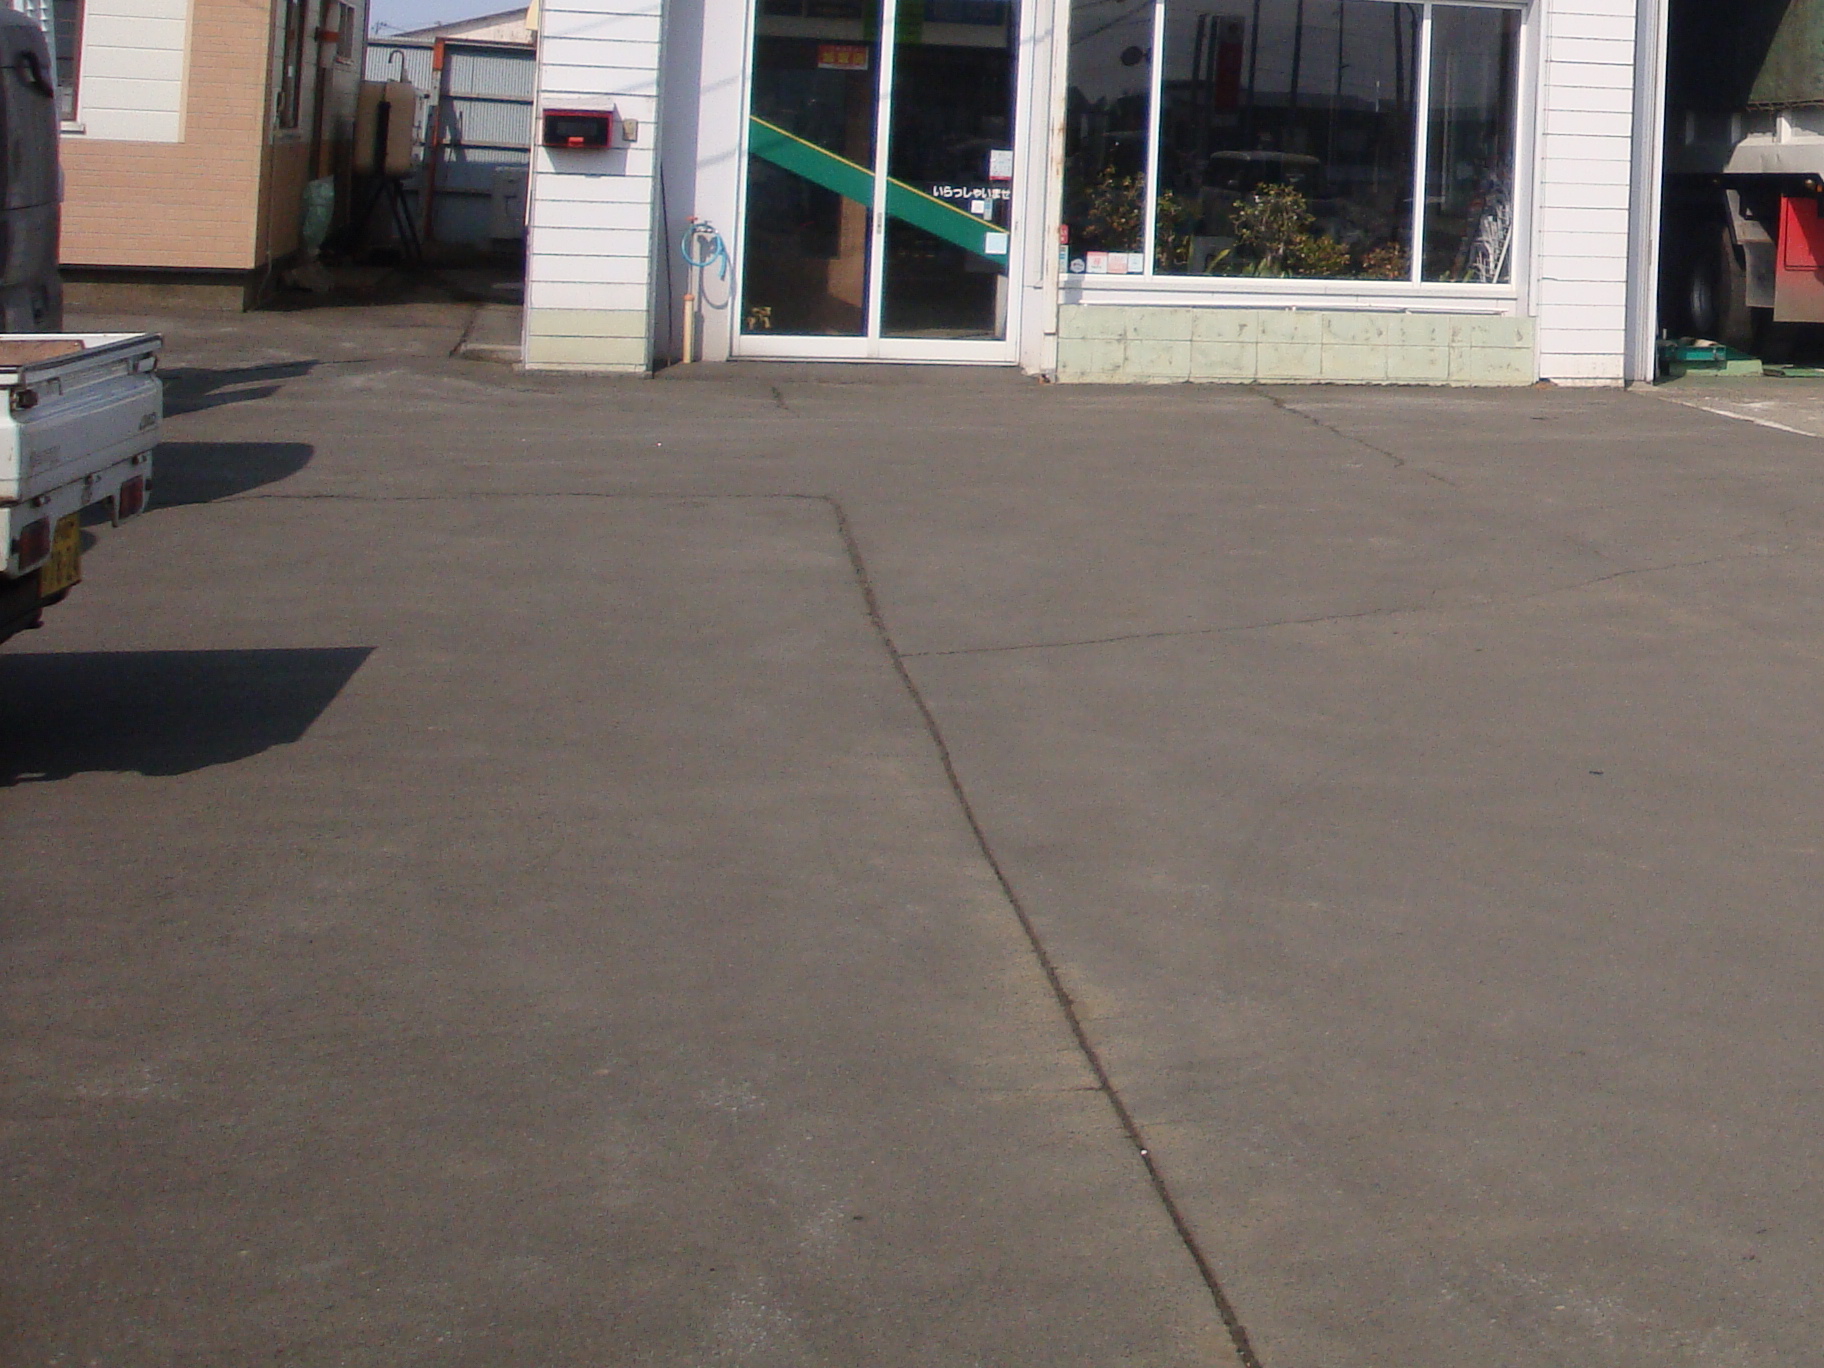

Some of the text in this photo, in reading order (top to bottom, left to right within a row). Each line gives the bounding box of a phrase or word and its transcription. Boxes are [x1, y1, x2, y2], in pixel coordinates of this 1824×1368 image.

[932, 185, 1011, 200] いらっしゃいませ
